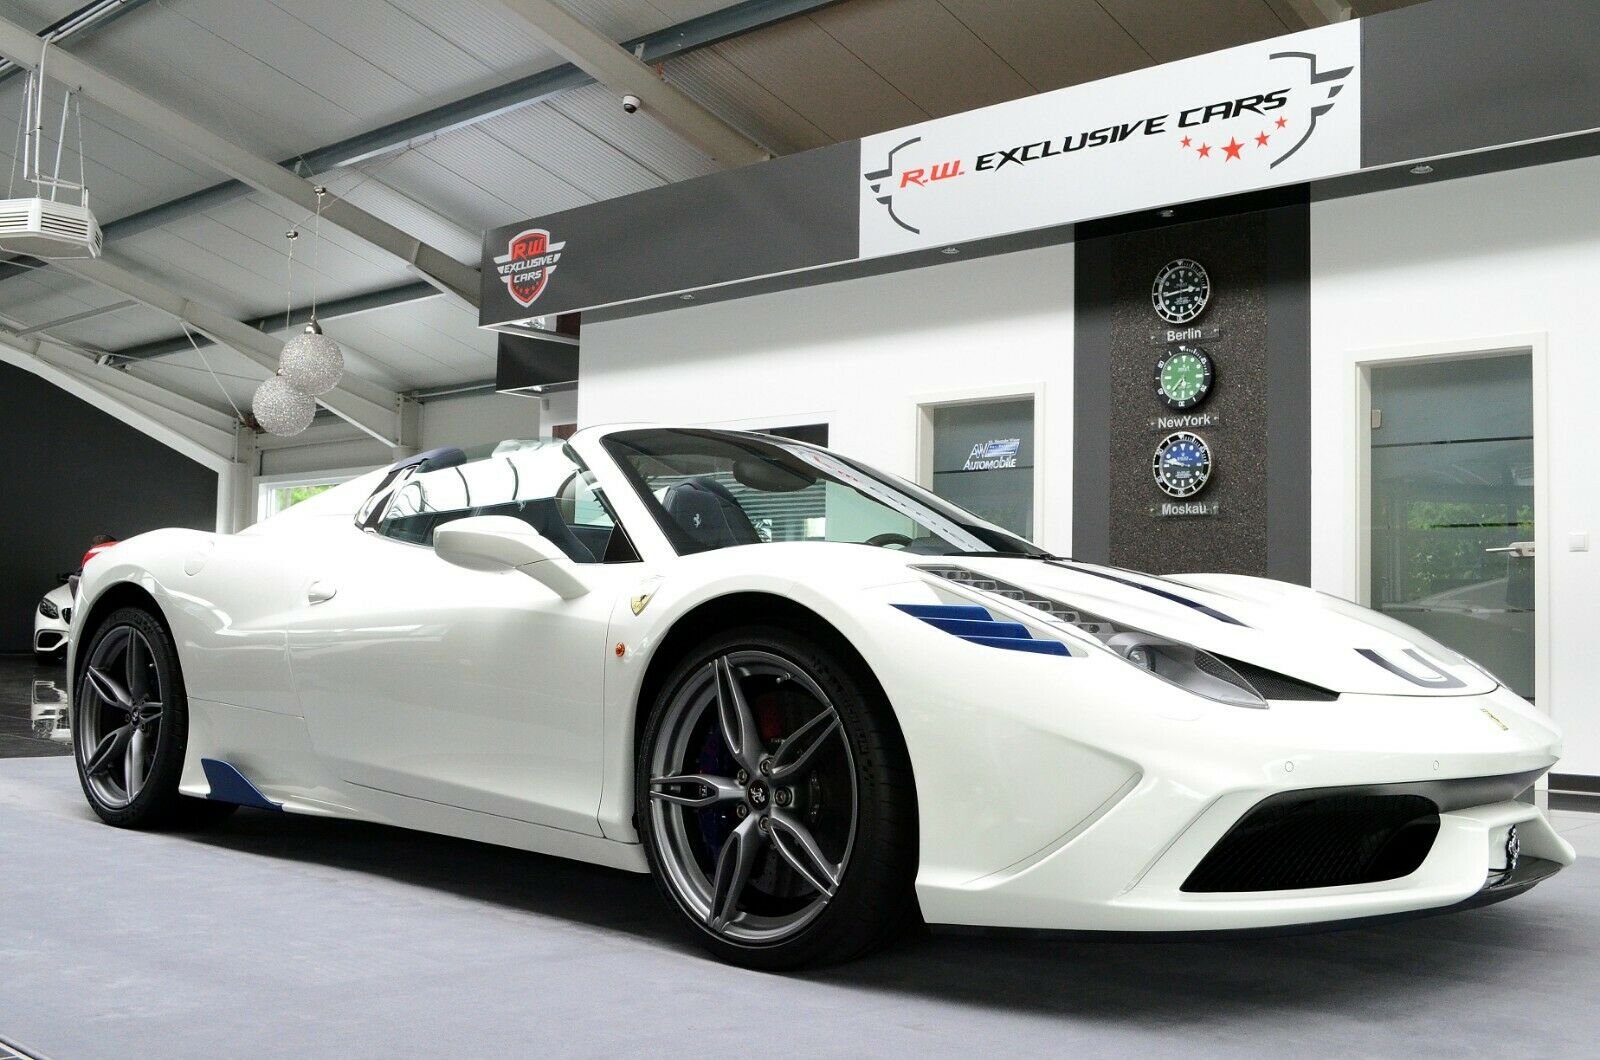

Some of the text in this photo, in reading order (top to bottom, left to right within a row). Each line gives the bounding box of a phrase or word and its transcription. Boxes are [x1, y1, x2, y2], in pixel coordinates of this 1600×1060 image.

[900, 88, 1292, 188] R.W. EXCLUSIVE CARS
[503, 255, 553, 273] EXCLUSIVE
[514, 269, 543, 283] CARS
[1167, 328, 1202, 341] Berlin
[1158, 413, 1211, 429] NewYork
[1161, 502, 1207, 516] Moskau
